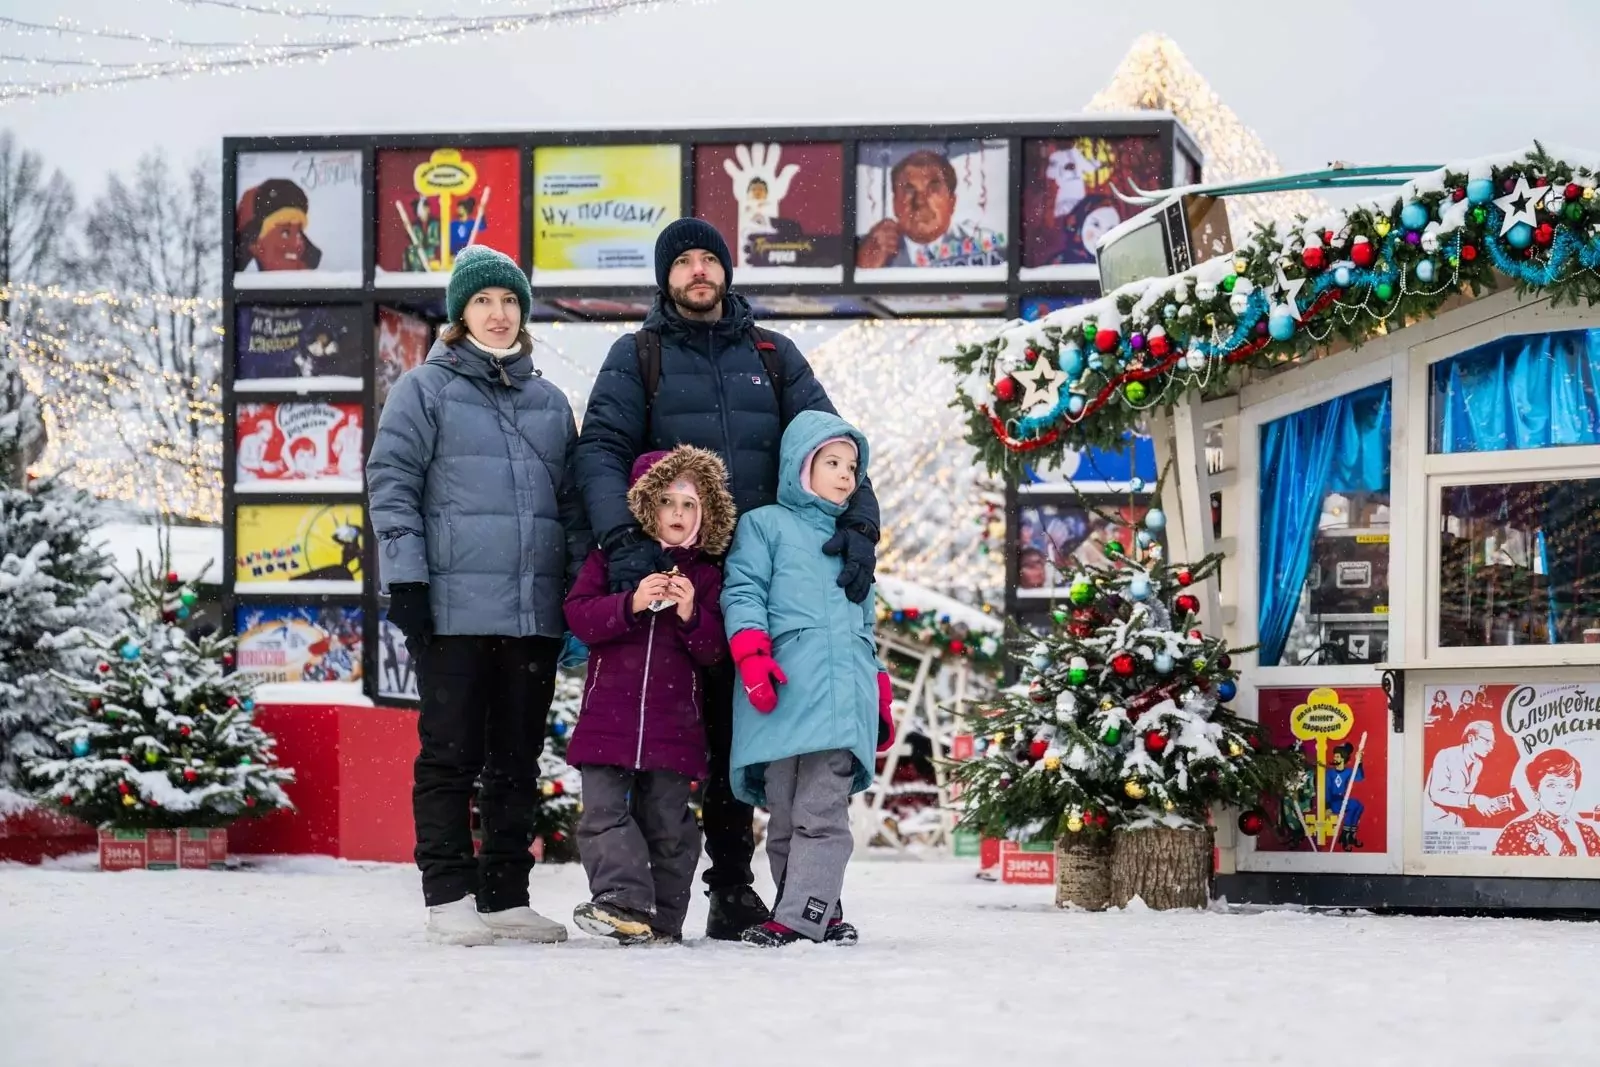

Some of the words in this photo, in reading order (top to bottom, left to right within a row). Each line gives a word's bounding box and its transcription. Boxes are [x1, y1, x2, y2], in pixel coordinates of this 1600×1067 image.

[577, 200, 667, 228] ПОГОДИ!
[1521, 718, 1600, 755] роман
[1007, 860, 1050, 871] ЗИМА
